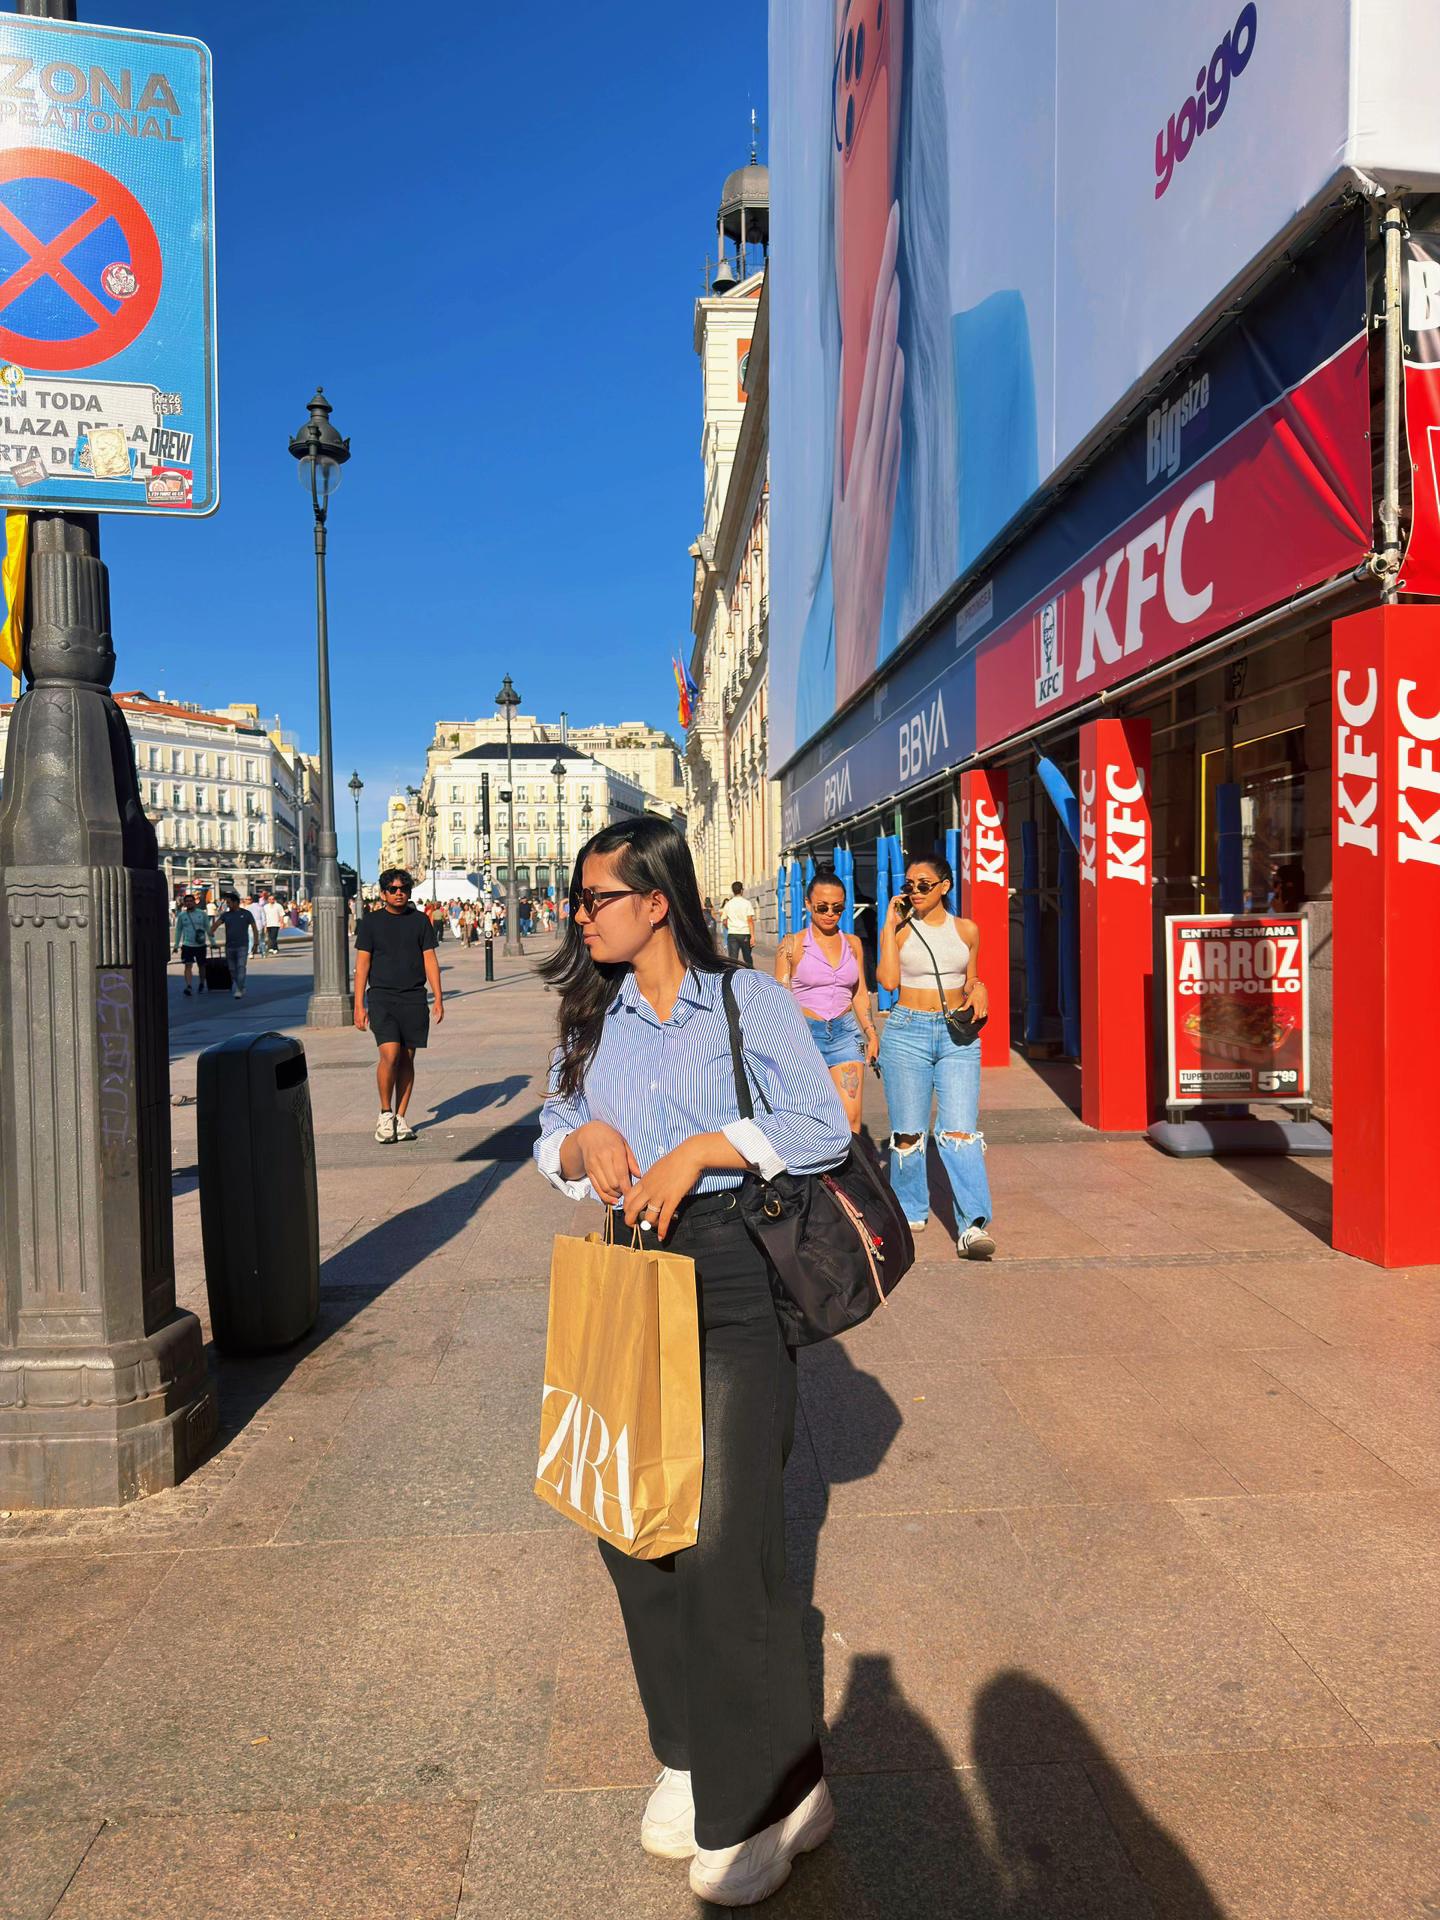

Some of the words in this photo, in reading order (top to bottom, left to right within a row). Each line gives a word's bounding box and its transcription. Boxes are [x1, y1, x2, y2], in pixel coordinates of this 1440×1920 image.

[0, 56, 182, 116] ZONA
[1155, 2, 1257, 200] yoigo
[0, 100, 183, 142] PEATONAL
[0, 416, 69, 437] LAZA
[36, 391, 103, 413] TODA
[148, 427, 192, 463] DREW
[1075, 480, 1216, 683] KFC
[1039, 672, 1060, 702] KFC
[900, 688, 949, 783] BBVA
[1337, 668, 1378, 856] KFC
[823, 759, 852, 820] BBVA
[961, 799, 971, 885] KFC
[976, 799, 1005, 887] KFC
[1081, 769, 1097, 887] KFC
[1106, 764, 1146, 886] KFC
[1179, 939, 1299, 981] ARROZ
[1181, 928, 1231, 939] ENTRE
[1234, 926, 1295, 937] SEMANA
[1178, 980, 1225, 996] CON
[1229, 978, 1301, 994] POLLO
[1181, 1072, 1212, 1081] TUPPER
[1213, 1071, 1250, 1081] COREANO
[537, 1383, 634, 1540] ZARA
